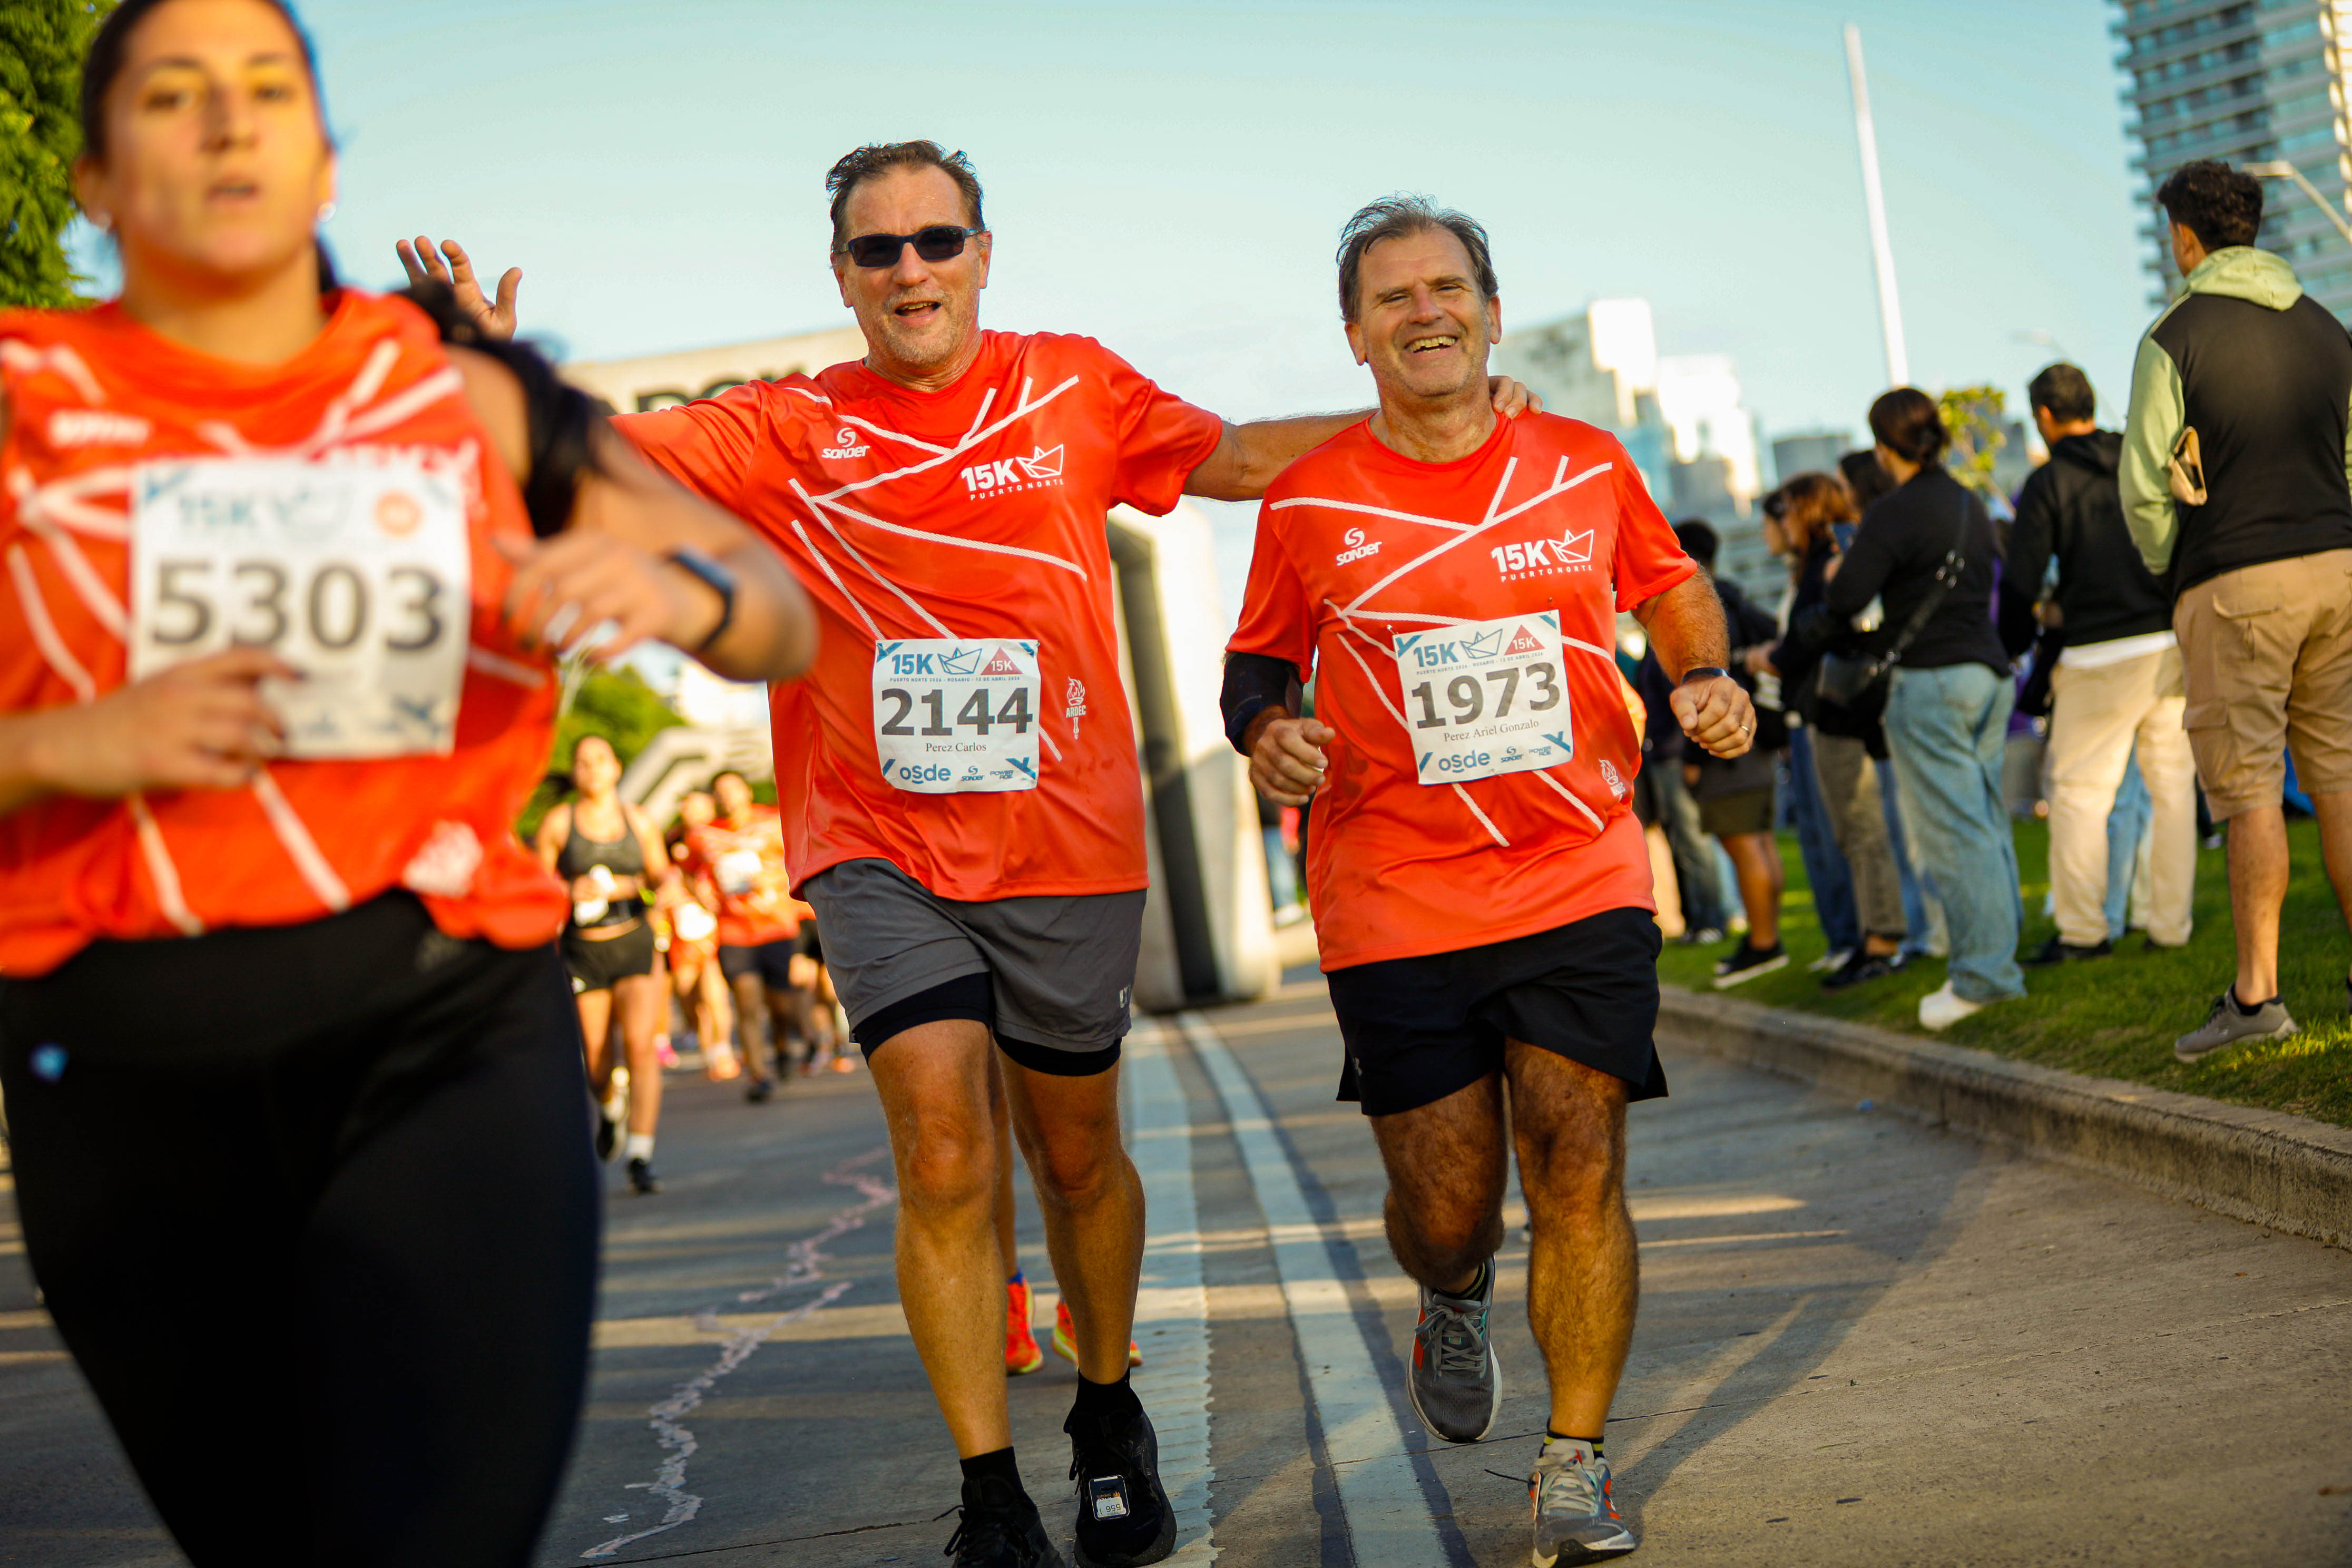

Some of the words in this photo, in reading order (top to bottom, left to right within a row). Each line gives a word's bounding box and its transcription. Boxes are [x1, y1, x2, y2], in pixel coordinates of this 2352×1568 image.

[961, 458, 1021, 492] 15K
[971, 484, 1023, 501] PUERTO
[1027, 478, 1065, 490] NORTE
[1491, 540, 1551, 573] 15K
[1501, 567, 1553, 582] PUERTO
[1557, 564, 1593, 574] NORTE
[150, 558, 445, 654] 5303
[1414, 641, 1459, 668] 15K
[1512, 636, 1536, 650] 15K
[891, 653, 934, 674] 15K
[991, 660, 1013, 672] 15K
[1412, 662, 1561, 729] 1973
[881, 687, 1033, 736] 2144
[1066, 705, 1086, 718] ARDEC
[1443, 731, 1471, 742] Perez
[1473, 726, 1497, 738] Ariel
[1500, 719, 1540, 733] Gonzalo
[926, 742, 953, 752] Perez
[955, 741, 987, 752] Carlos
[899, 763, 952, 783] osde
[1438, 750, 1491, 773] osde
[1105, 1503, 1121, 1513] 556
